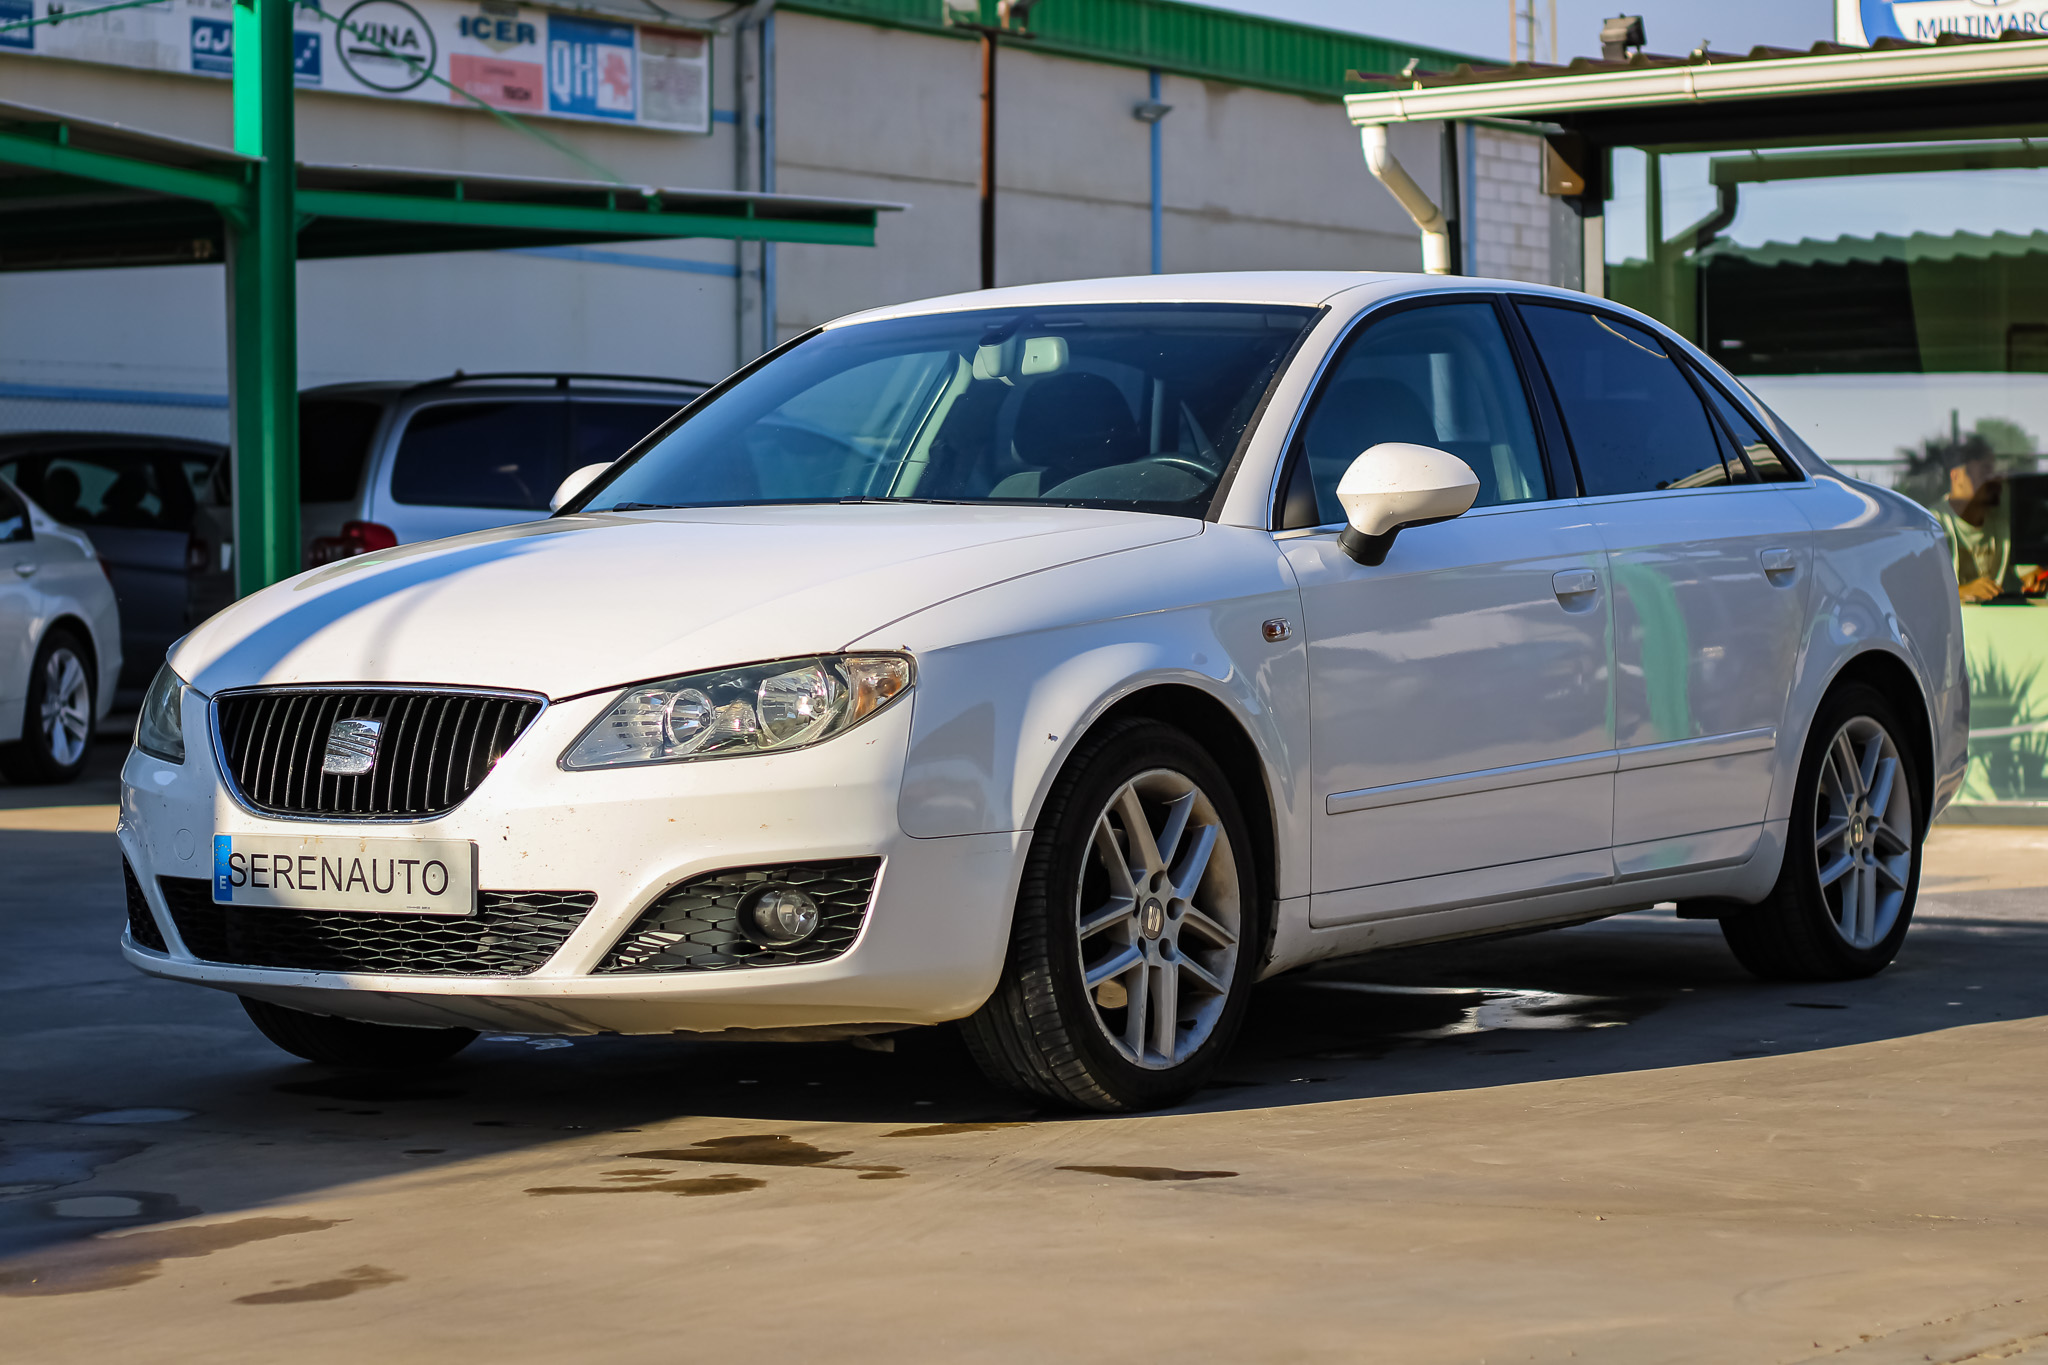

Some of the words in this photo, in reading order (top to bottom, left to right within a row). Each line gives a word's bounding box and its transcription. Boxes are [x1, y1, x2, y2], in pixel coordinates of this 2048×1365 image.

[347, 20, 420, 49] VINA
[460, 15, 536, 45] ICER
[219, 875, 227, 890] E
[228, 853, 449, 896] SERENAUTO
